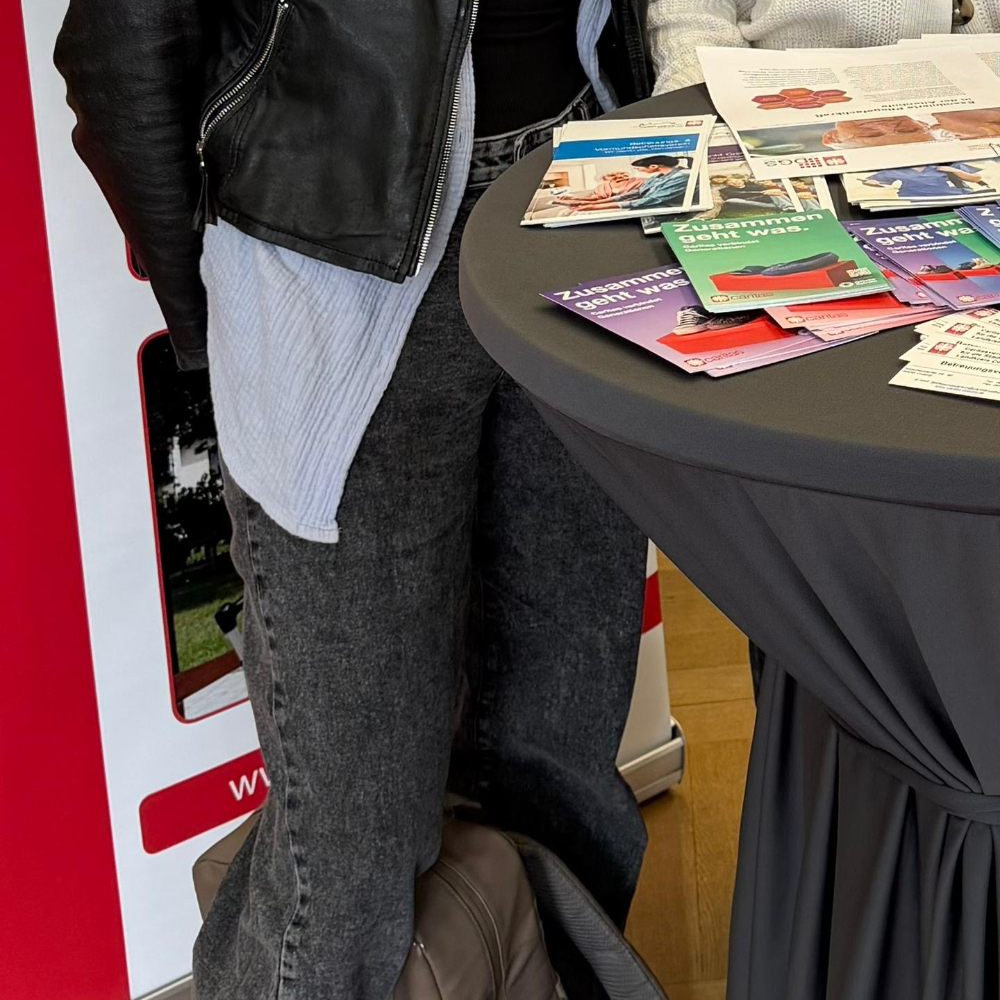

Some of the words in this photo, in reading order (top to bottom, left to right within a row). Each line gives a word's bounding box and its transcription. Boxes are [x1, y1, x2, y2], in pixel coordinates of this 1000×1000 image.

[672, 212, 824, 233] Zusammen
[678, 231, 741, 244] geht
[746, 225, 810, 237] was.
[875, 231, 934, 246] geht
[575, 291, 638, 311] geht
[729, 291, 775, 301] caritas
[804, 311, 849, 323] caritas
[704, 349, 745, 364] caritas
